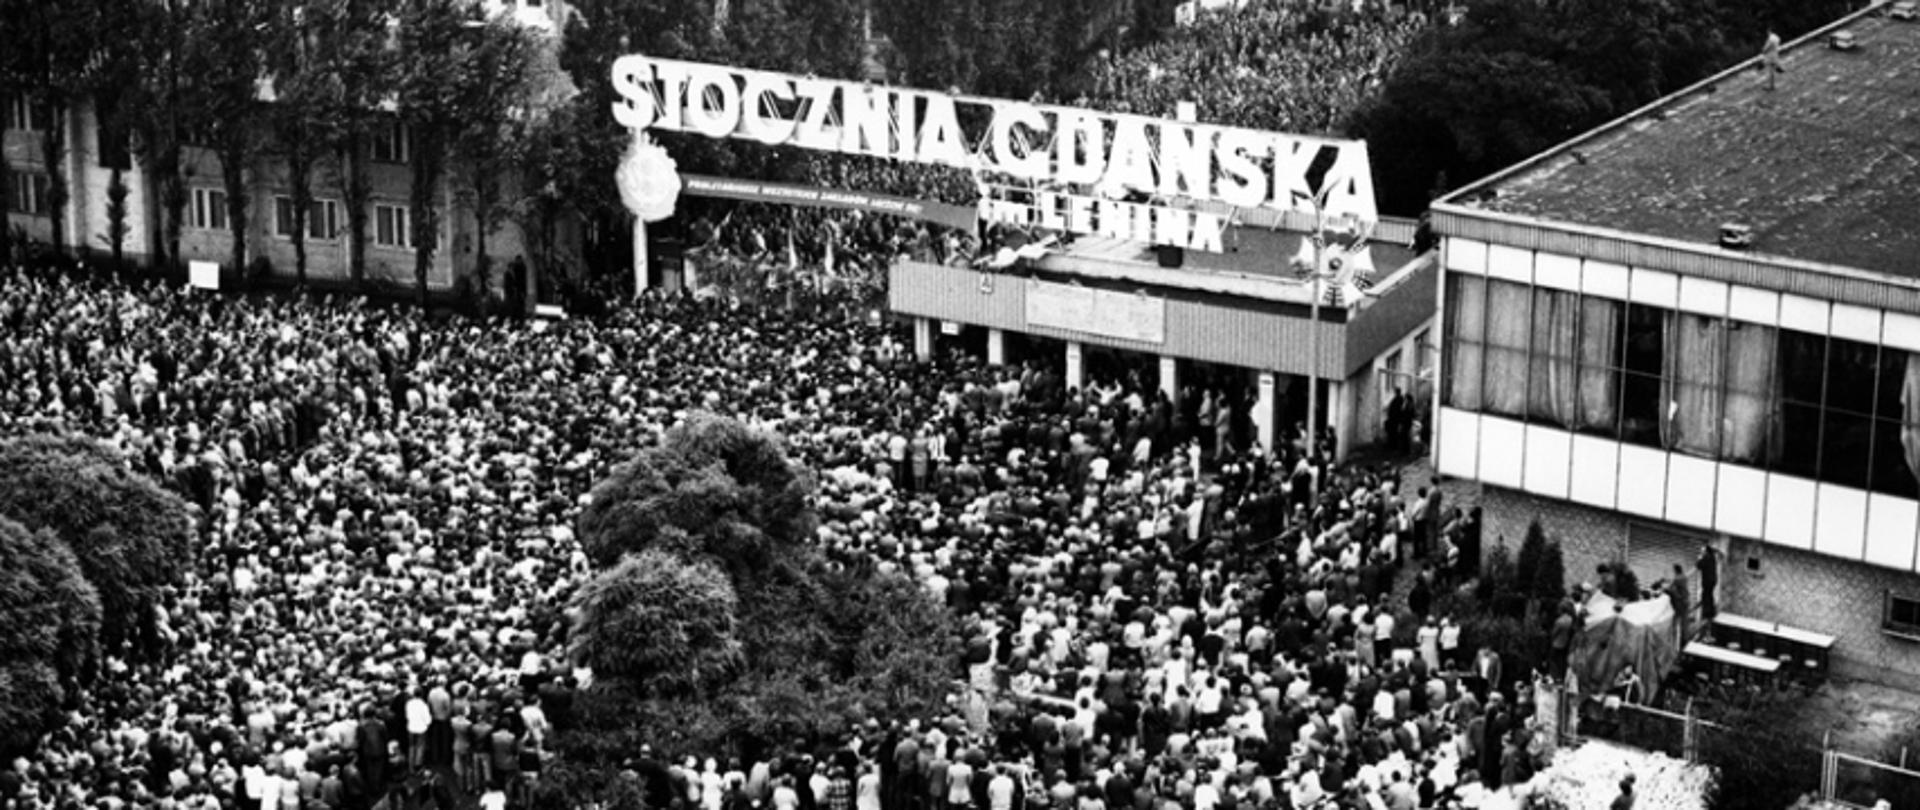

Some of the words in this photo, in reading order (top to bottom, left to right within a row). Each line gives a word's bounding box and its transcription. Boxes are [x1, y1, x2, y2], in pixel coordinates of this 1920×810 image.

[611, 54, 972, 168] STOCZNIA
[990, 101, 1378, 222] GDAŃSKA
[1040, 191, 1223, 253] LENINA
